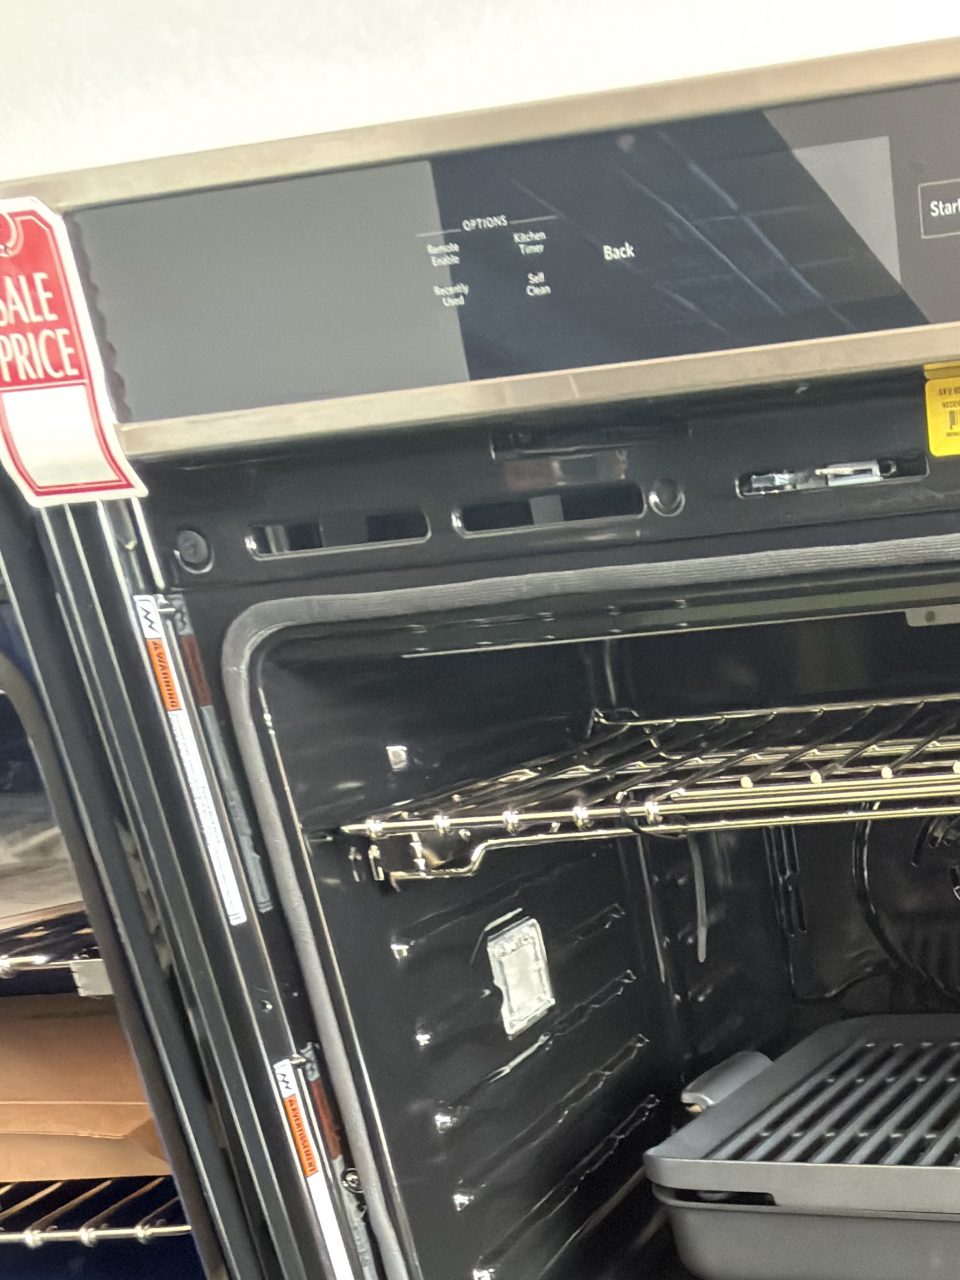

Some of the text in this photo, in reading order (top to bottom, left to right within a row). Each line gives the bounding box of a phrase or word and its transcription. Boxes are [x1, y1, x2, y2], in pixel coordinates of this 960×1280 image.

[462, 215, 508, 231] OPTIONS
[513, 230, 547, 243] Kitchen
[426, 243, 460, 254] Remote
[518, 243, 545, 255] Timer
[603, 241, 636, 260] Back
[430, 254, 460, 267] Enable
[527, 272, 545, 284] Self
[432, 282, 470, 296] Recently
[525, 285, 552, 297] Clean
[441, 295, 465, 307] Used
[0, 328, 79, 382] PRICE
